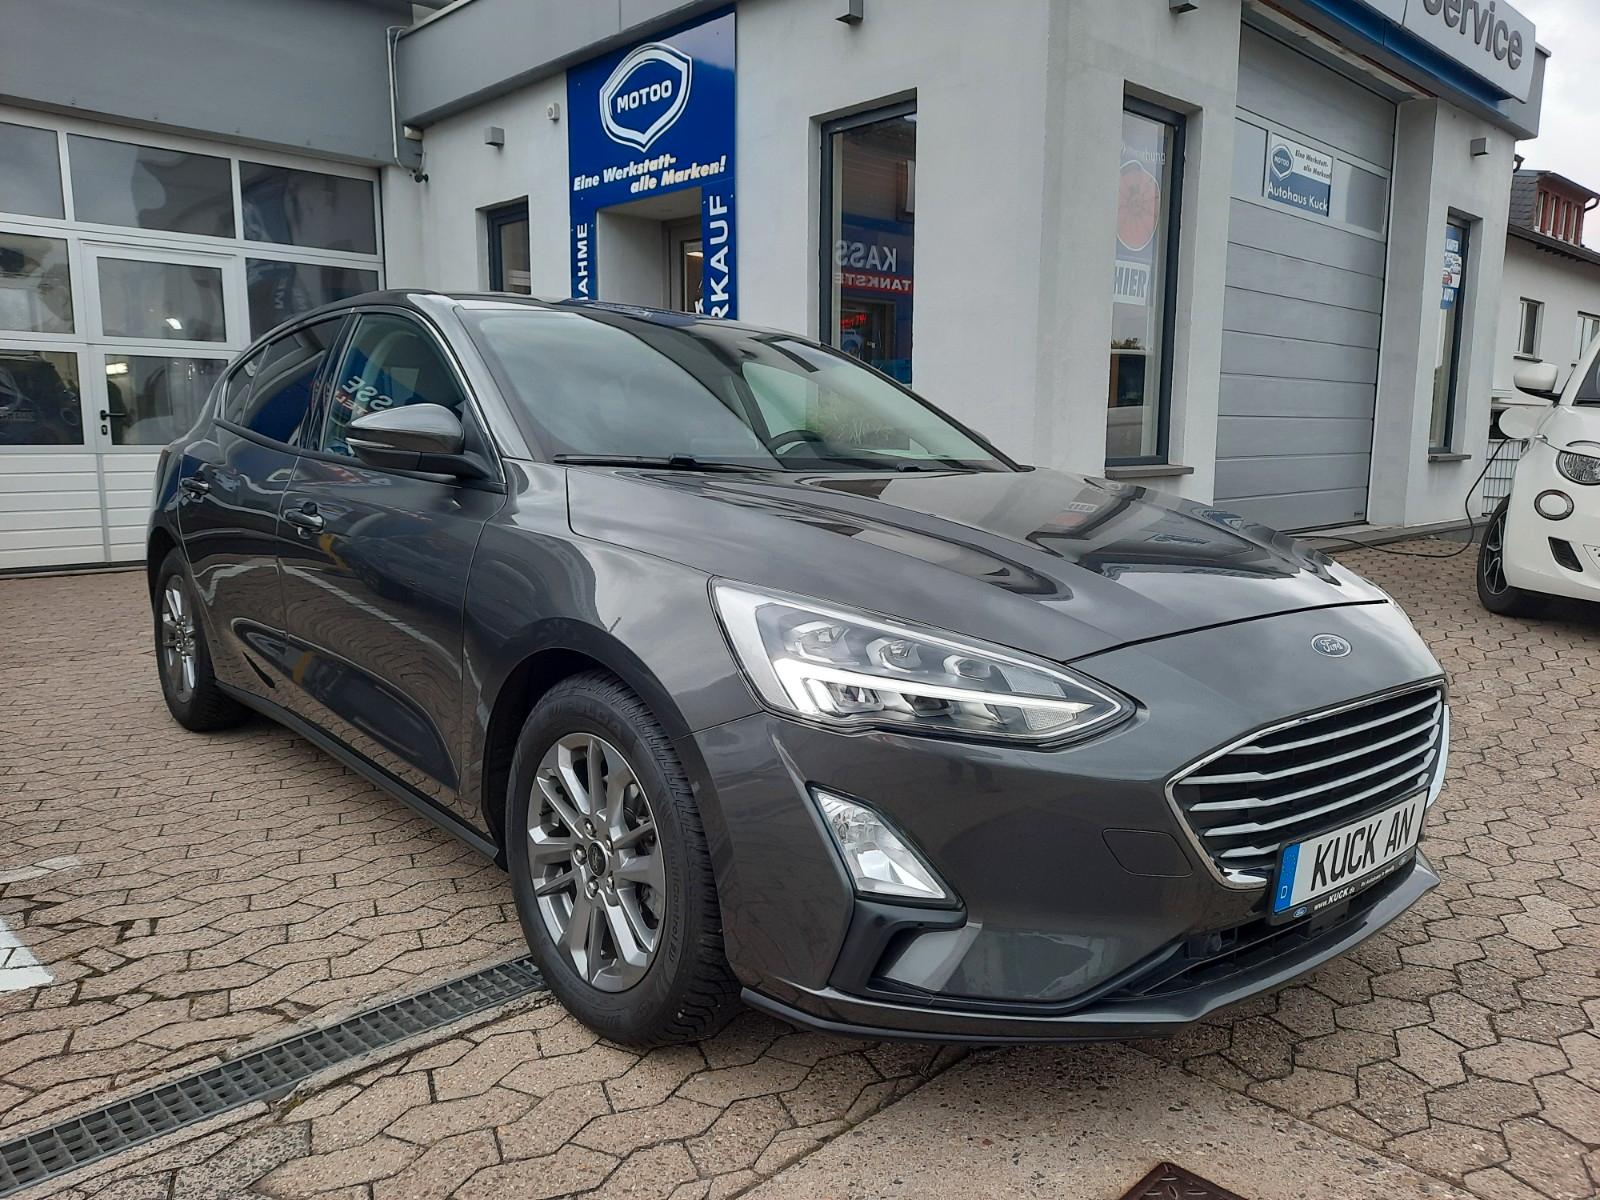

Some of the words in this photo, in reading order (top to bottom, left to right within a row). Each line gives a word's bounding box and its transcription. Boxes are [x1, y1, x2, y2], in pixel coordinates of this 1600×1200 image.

[1423, 0, 1523, 70] ervice
[617, 80, 672, 113] MOTOO
[573, 174, 600, 191] Eine
[603, 153, 677, 183] Werkstatt-
[630, 175, 657, 194] alle
[661, 155, 727, 187] Marken!
[1267, 182, 1307, 205] Autohaus
[1309, 194, 1328, 212] Kuck
[577, 223, 588, 300] AHME
[1113, 265, 1148, 297] HIER
[1310, 820, 1383, 892] KUCK
[1384, 803, 1416, 858] AN
[1281, 885, 1288, 899] D
